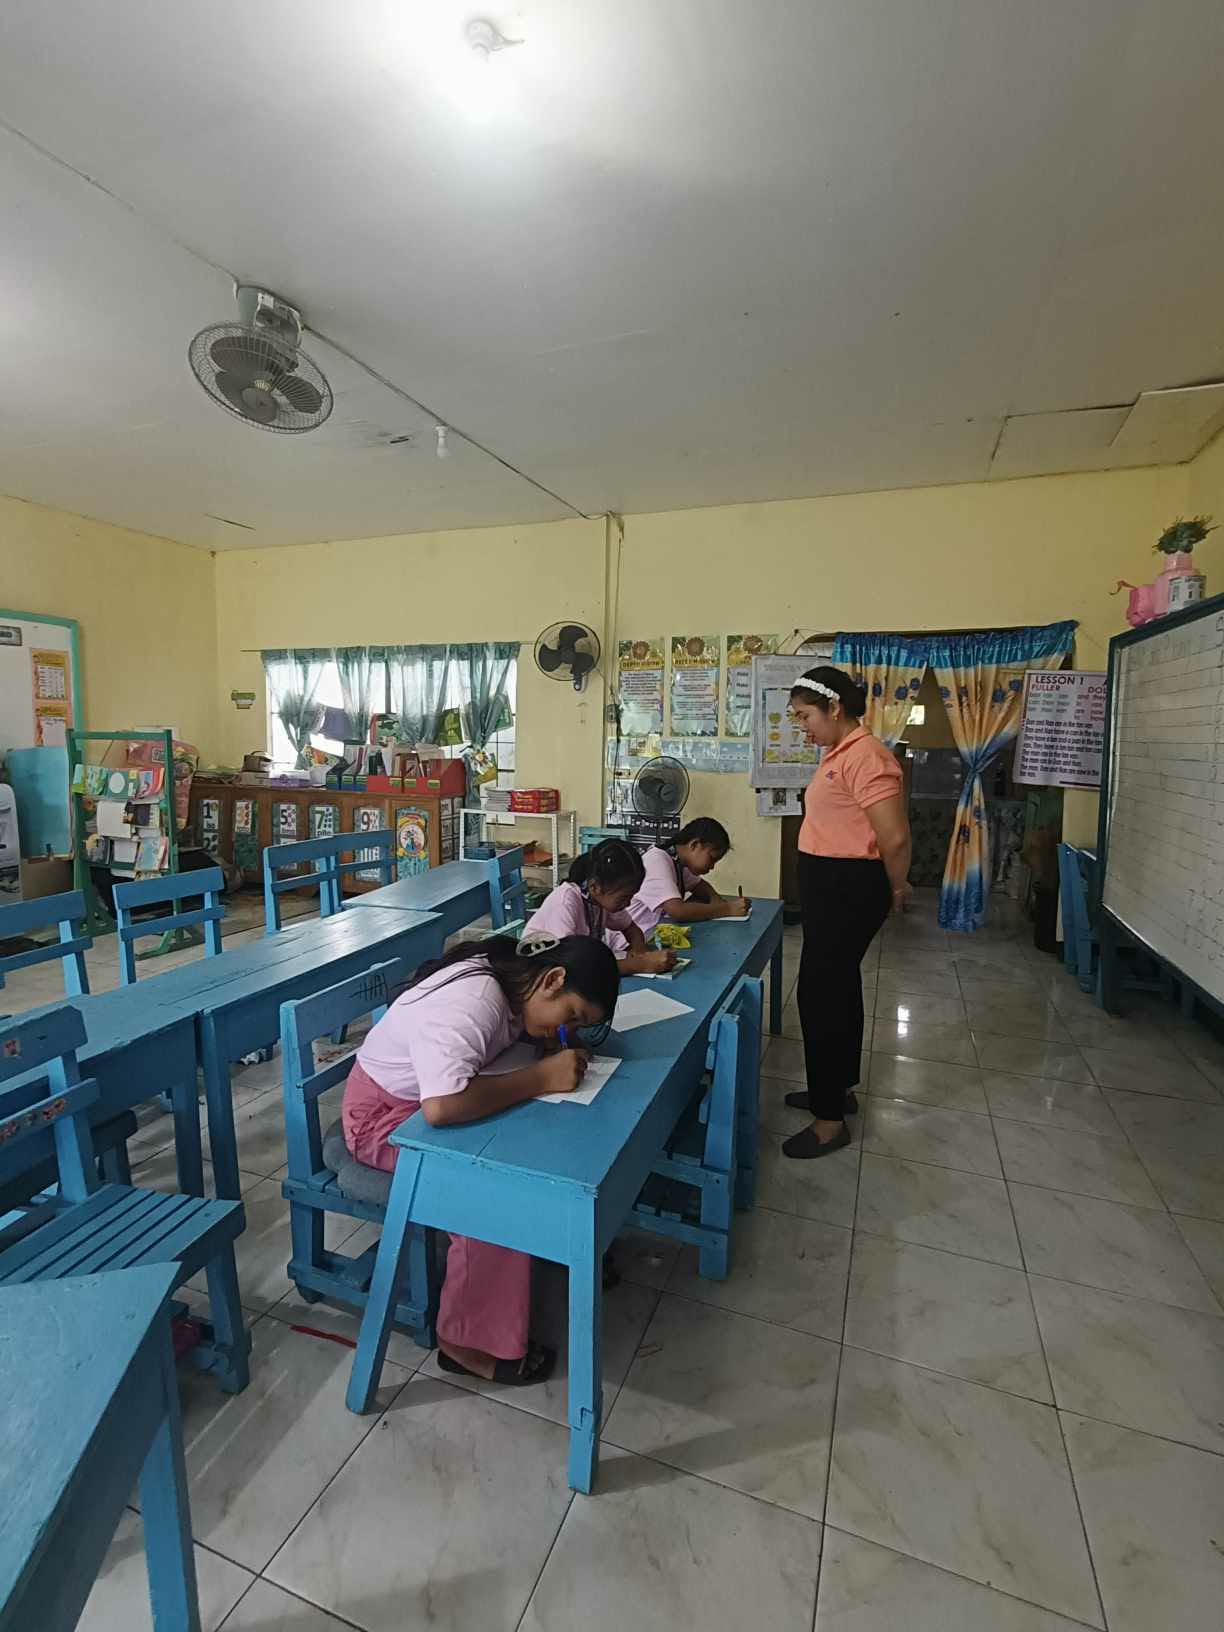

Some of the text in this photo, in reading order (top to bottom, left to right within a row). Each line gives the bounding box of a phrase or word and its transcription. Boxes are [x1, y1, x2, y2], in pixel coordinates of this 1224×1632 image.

[1036, 675, 1084, 685] LESSON 1
[202, 802, 212, 818] 1
[280, 809, 288, 825] 5
[314, 810, 325, 829] 7
[361, 812, 370, 831] 9
